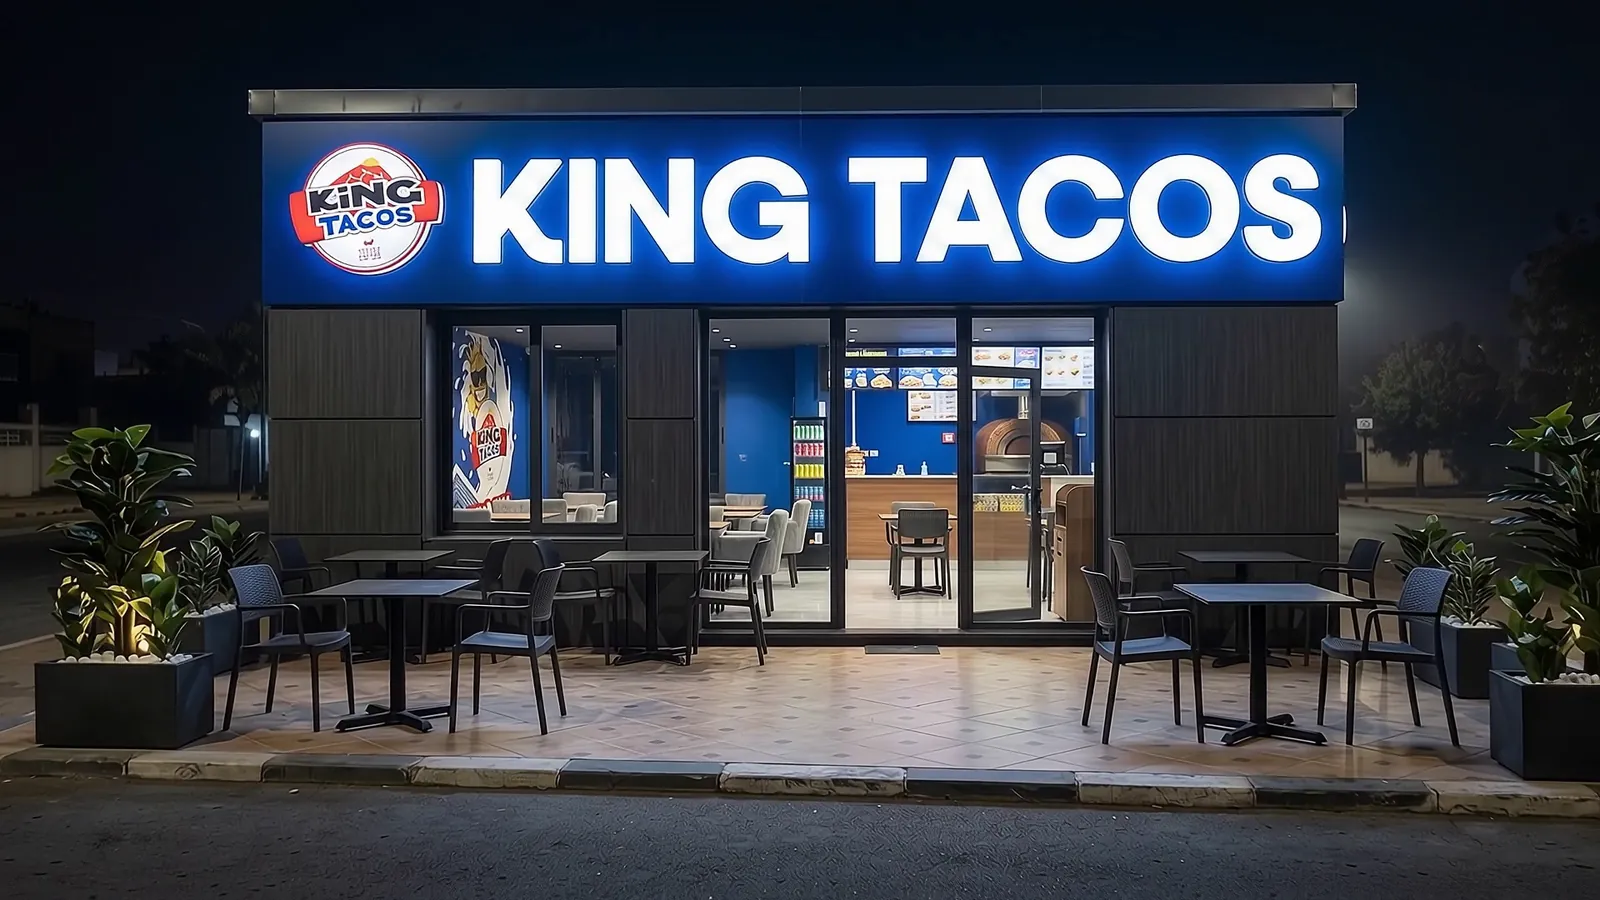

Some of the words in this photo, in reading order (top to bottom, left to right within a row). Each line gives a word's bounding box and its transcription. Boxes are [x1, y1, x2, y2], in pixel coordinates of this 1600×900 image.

[318, 206, 413, 236] TACOS
[472, 156, 810, 264] KING
[848, 154, 1322, 263] TACOS
